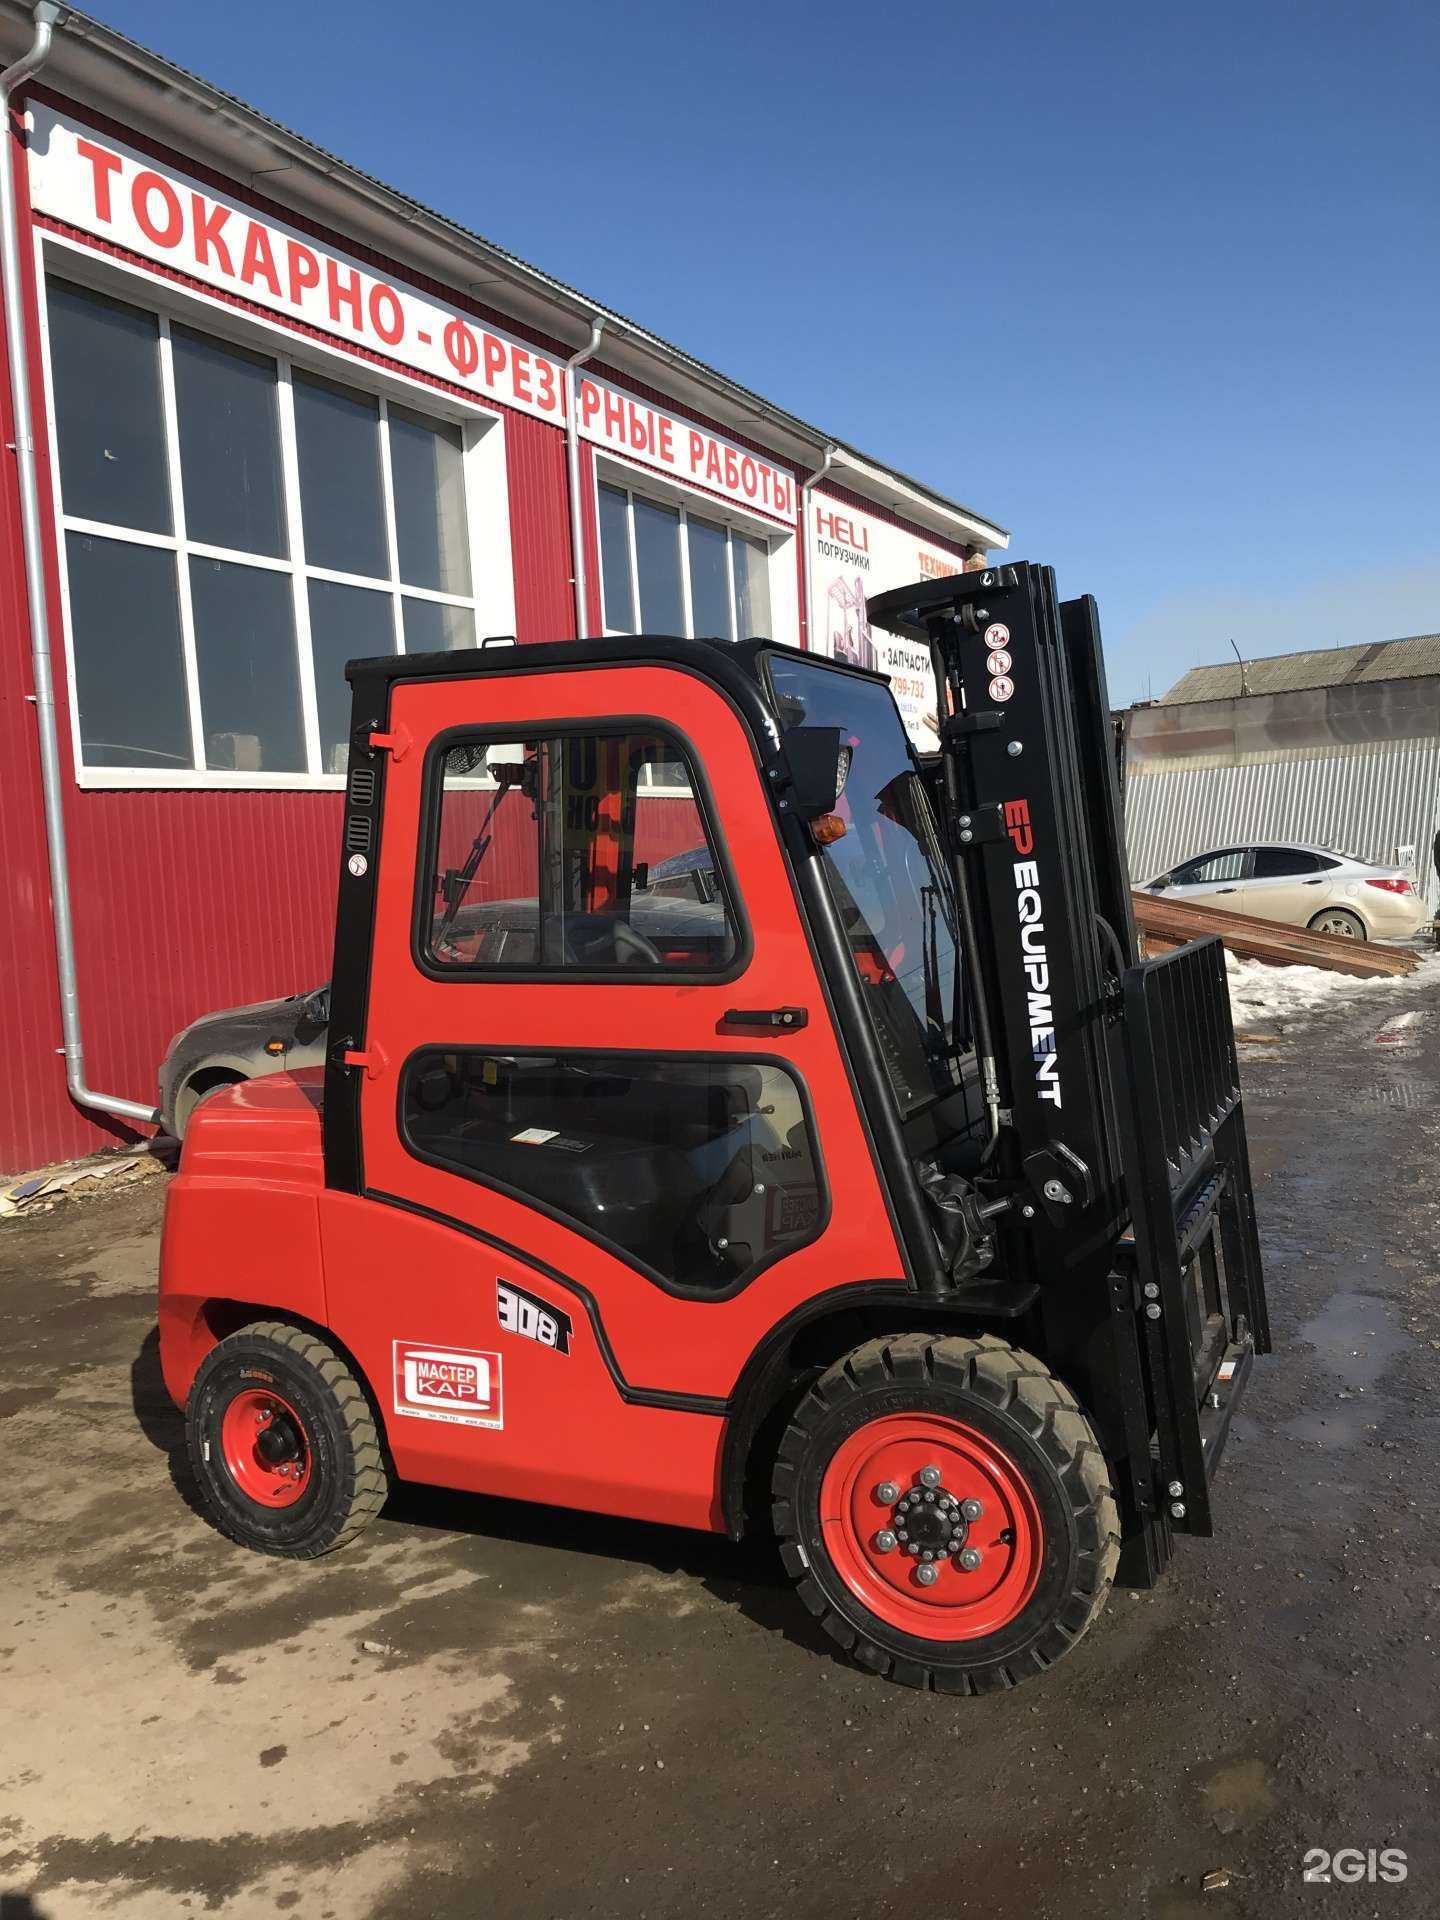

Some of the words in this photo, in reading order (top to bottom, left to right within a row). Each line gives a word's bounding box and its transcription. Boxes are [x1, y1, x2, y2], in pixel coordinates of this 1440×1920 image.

[76, 138, 404, 347] ТОКАРНО
[689, 430, 792, 515] РАБОТЫ
[816, 507, 868, 553] HELI
[817, 539, 871, 571] ПОГРУЗЧИКИ
[887, 647, 931, 674] ЗАПЧАСТИ
[1004, 799, 1035, 855] EP
[1013, 860, 1063, 1110] EQUIPMENT
[418, 1361, 475, 1384] МАСТЕР
[419, 1379, 476, 1398] КАР
